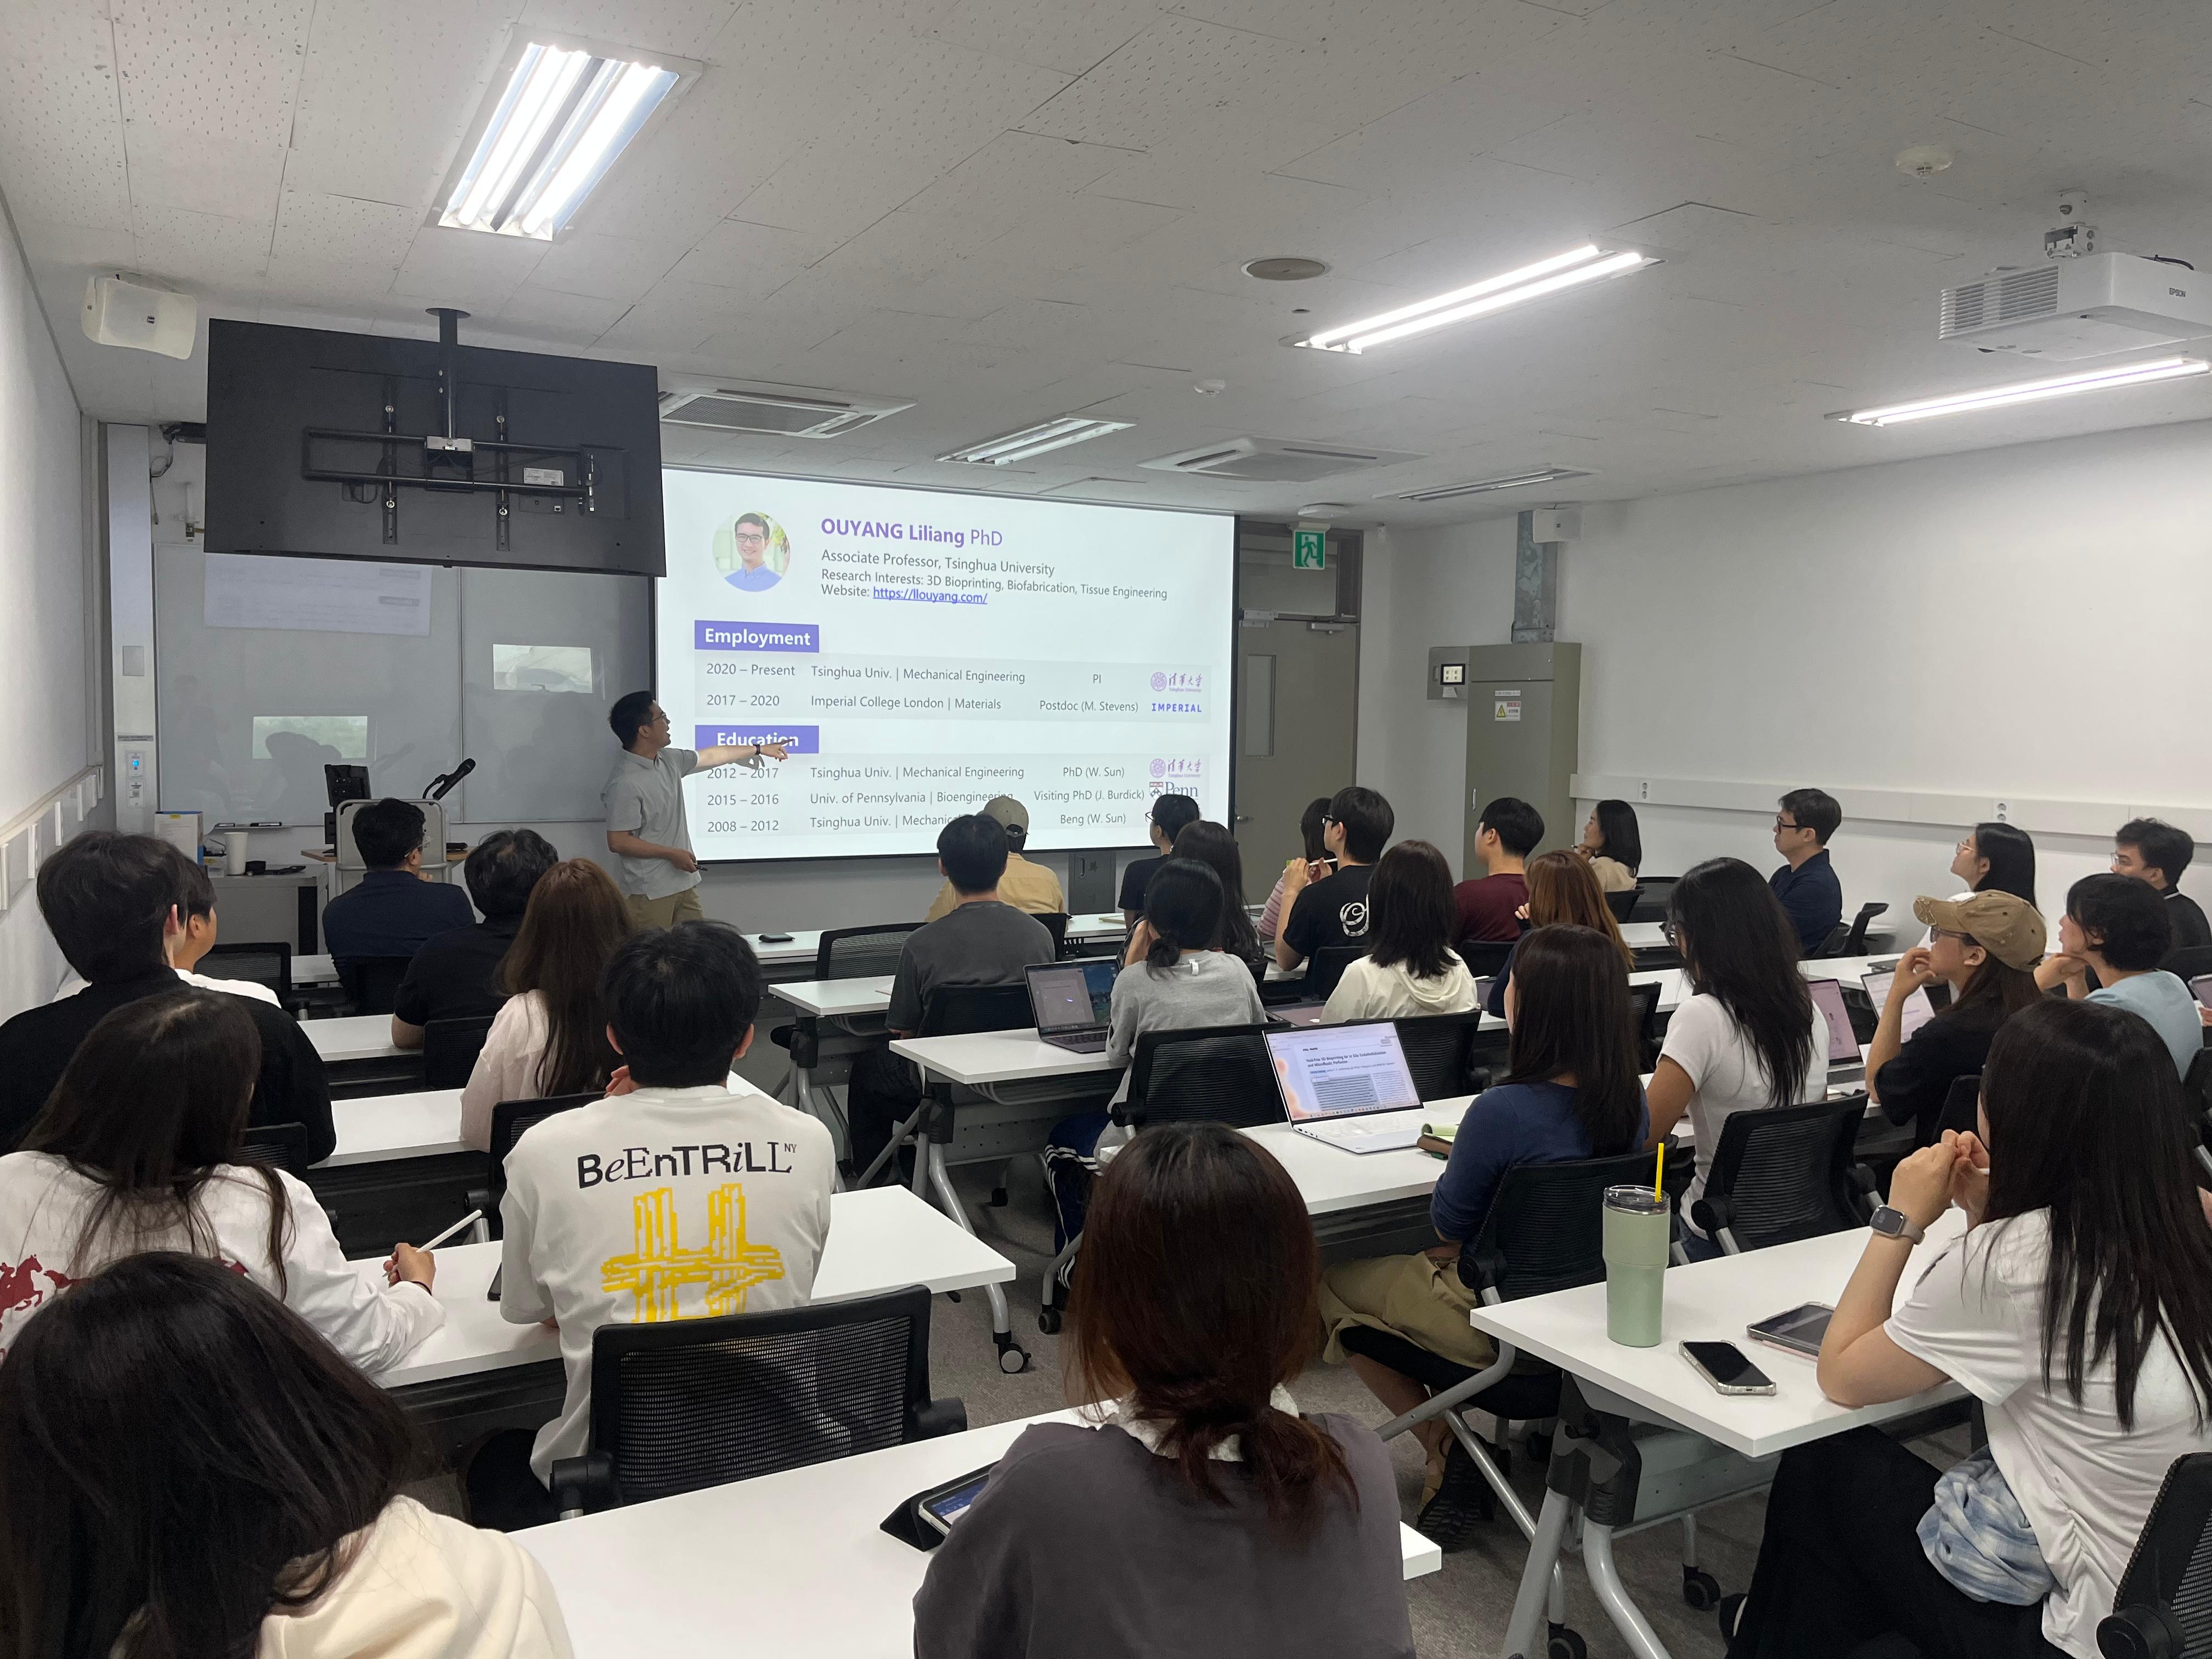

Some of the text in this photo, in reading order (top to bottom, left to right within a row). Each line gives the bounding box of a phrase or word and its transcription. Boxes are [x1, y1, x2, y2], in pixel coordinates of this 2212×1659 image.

[2169, 287, 2186, 297] EPSON
[821, 518, 1003, 548] OUYANG Liliang PhD
[821, 549, 1055, 578] Associate Professor, Tsinghua University
[822, 569, 1167, 601] Research Interests: 3D Bioprinting, Biofabrication, Tissue Engineering
[821, 584, 988, 604] Website: https://llouyang.com/
[705, 628, 811, 648] Employment
[707, 664, 736, 674] 2020
[752, 664, 795, 676] Present
[811, 666, 861, 680] Tsinghua
[865, 667, 892, 679] Univ.
[904, 668, 962, 680] Mechanical
[966, 670, 1025, 684] Engineering
[707, 695, 736, 706] 2017
[751, 695, 780, 706] 2020
[811, 696, 856, 708] Imperial
[860, 696, 901, 710] College
[904, 697, 944, 708] London
[955, 698, 1001, 709] Materials
[1040, 700, 1138, 713] Postdoc (M. Stevens)
[1152, 703, 1202, 712] IMPERIAL
[717, 732, 799, 747] Education
[707, 768, 736, 778] 2012
[751, 768, 779, 778] 2017
[811, 768, 861, 780] Tsinghua
[865, 767, 891, 777] Univ.
[903, 766, 961, 777] Mechanical
[965, 767, 1024, 779] Engineering
[1063, 767, 1124, 778] PhD (W. Sun)
[1034, 789, 1144, 803] Visiting PhD (J. Burdick)
[1165, 782, 1199, 797] Penn
[707, 795, 736, 805] 2015
[751, 794, 779, 805] 2016
[811, 793, 838, 804] Univ.
[842, 793, 854, 804] of
[857, 792, 926, 805] Pennsylvania
[708, 821, 737, 832] 2008
[751, 821, 779, 831] 2012
[810, 817, 860, 830] Tsinghua
[864, 816, 891, 827] Univ.
[902, 814, 961, 826] Mechanic
[1060, 814, 1126, 826] Beng (W. Sun)
[785, 1143, 797, 1154] NY
